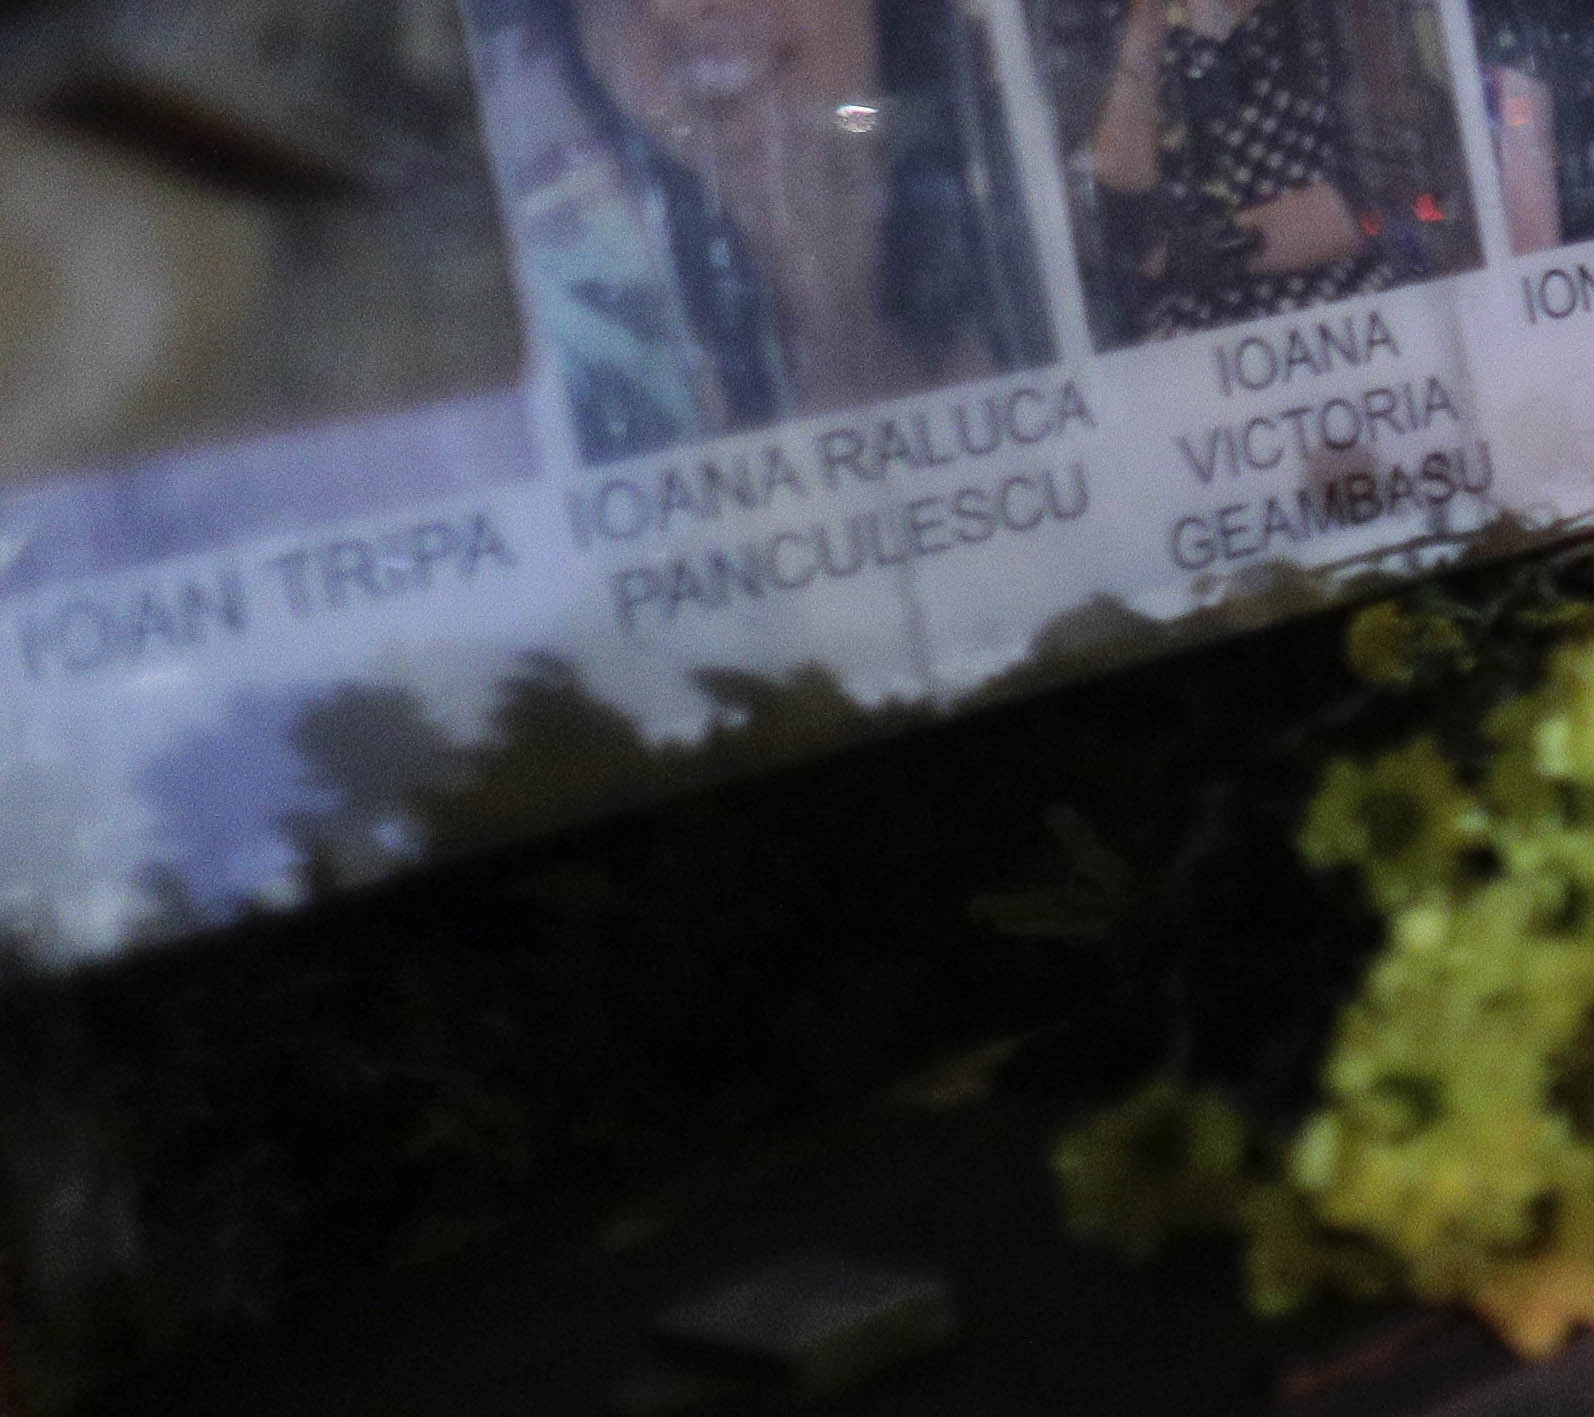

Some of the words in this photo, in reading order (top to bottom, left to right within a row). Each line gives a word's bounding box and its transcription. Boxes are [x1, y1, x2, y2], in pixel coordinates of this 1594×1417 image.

[1213, 309, 1401, 398] IOANA
[566, 452, 801, 552] IOANA
[811, 379, 1097, 492] RALUCA
[1175, 375, 1461, 486] VICTORIA
[611, 464, 1092, 634] PANCULESCU
[18, 566, 248, 681] IOAN
